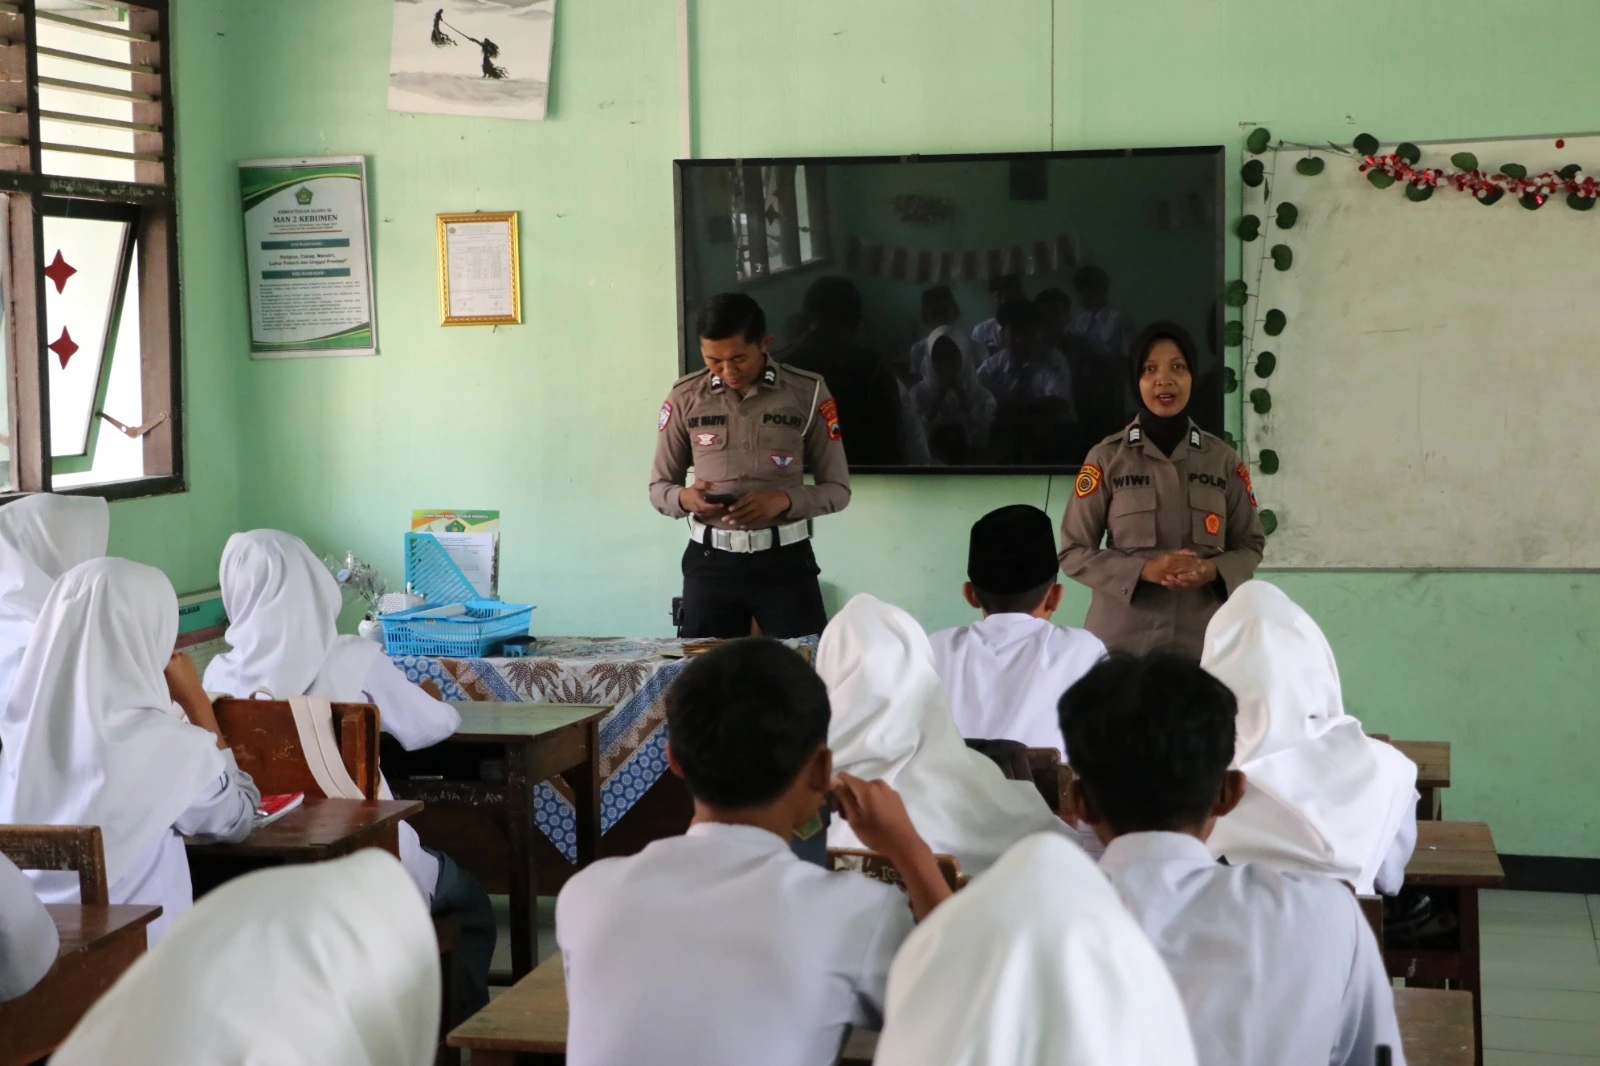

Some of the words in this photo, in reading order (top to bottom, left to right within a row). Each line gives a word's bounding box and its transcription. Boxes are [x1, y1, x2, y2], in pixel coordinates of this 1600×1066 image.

[272, 216, 291, 224] MAN
[299, 214, 339, 223] KEBUMEN
[763, 413, 803, 426] POLRI
[1112, 475, 1151, 489] WIWI
[1188, 472, 1227, 491] POLRI
